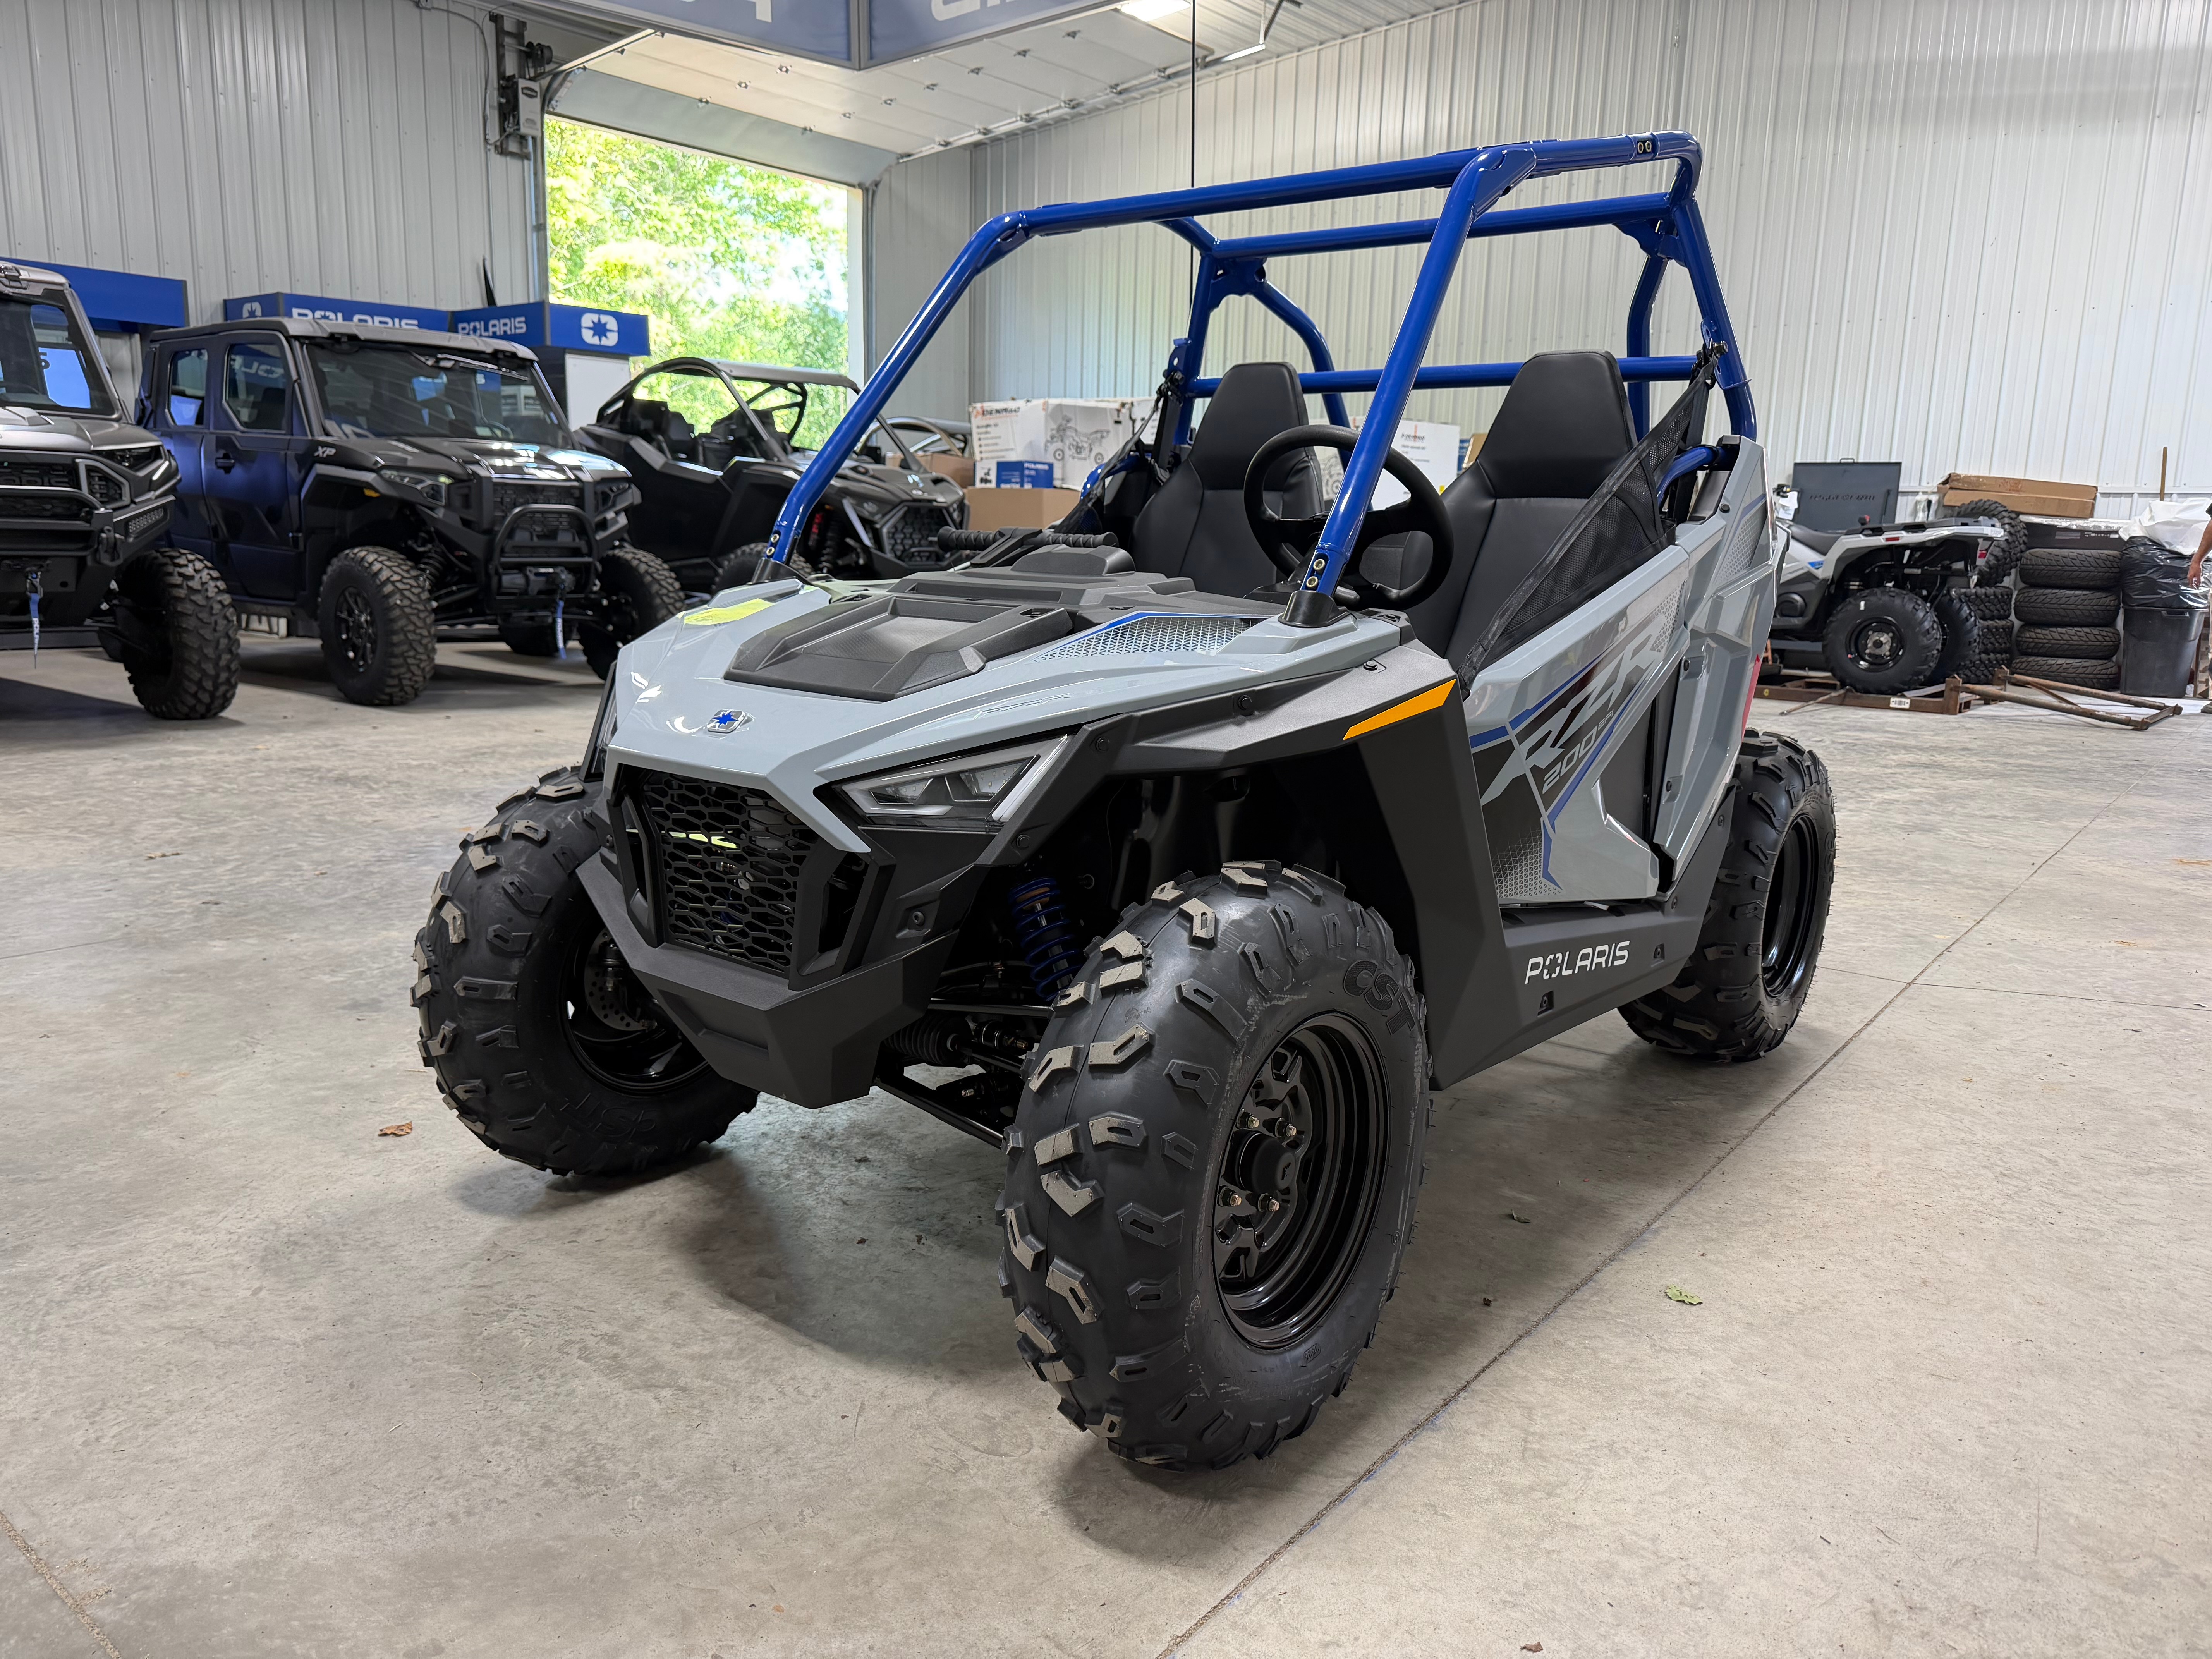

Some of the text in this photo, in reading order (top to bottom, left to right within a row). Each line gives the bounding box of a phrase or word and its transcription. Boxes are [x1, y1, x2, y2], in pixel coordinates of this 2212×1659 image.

[458, 316, 527, 337] POLARIS
[313, 445, 337, 458] XP
[1480, 614, 1664, 806] RZR
[1542, 725, 1598, 794] 200
[1525, 941, 1630, 984] POLARIS
[1343, 959, 1415, 1036] CST
